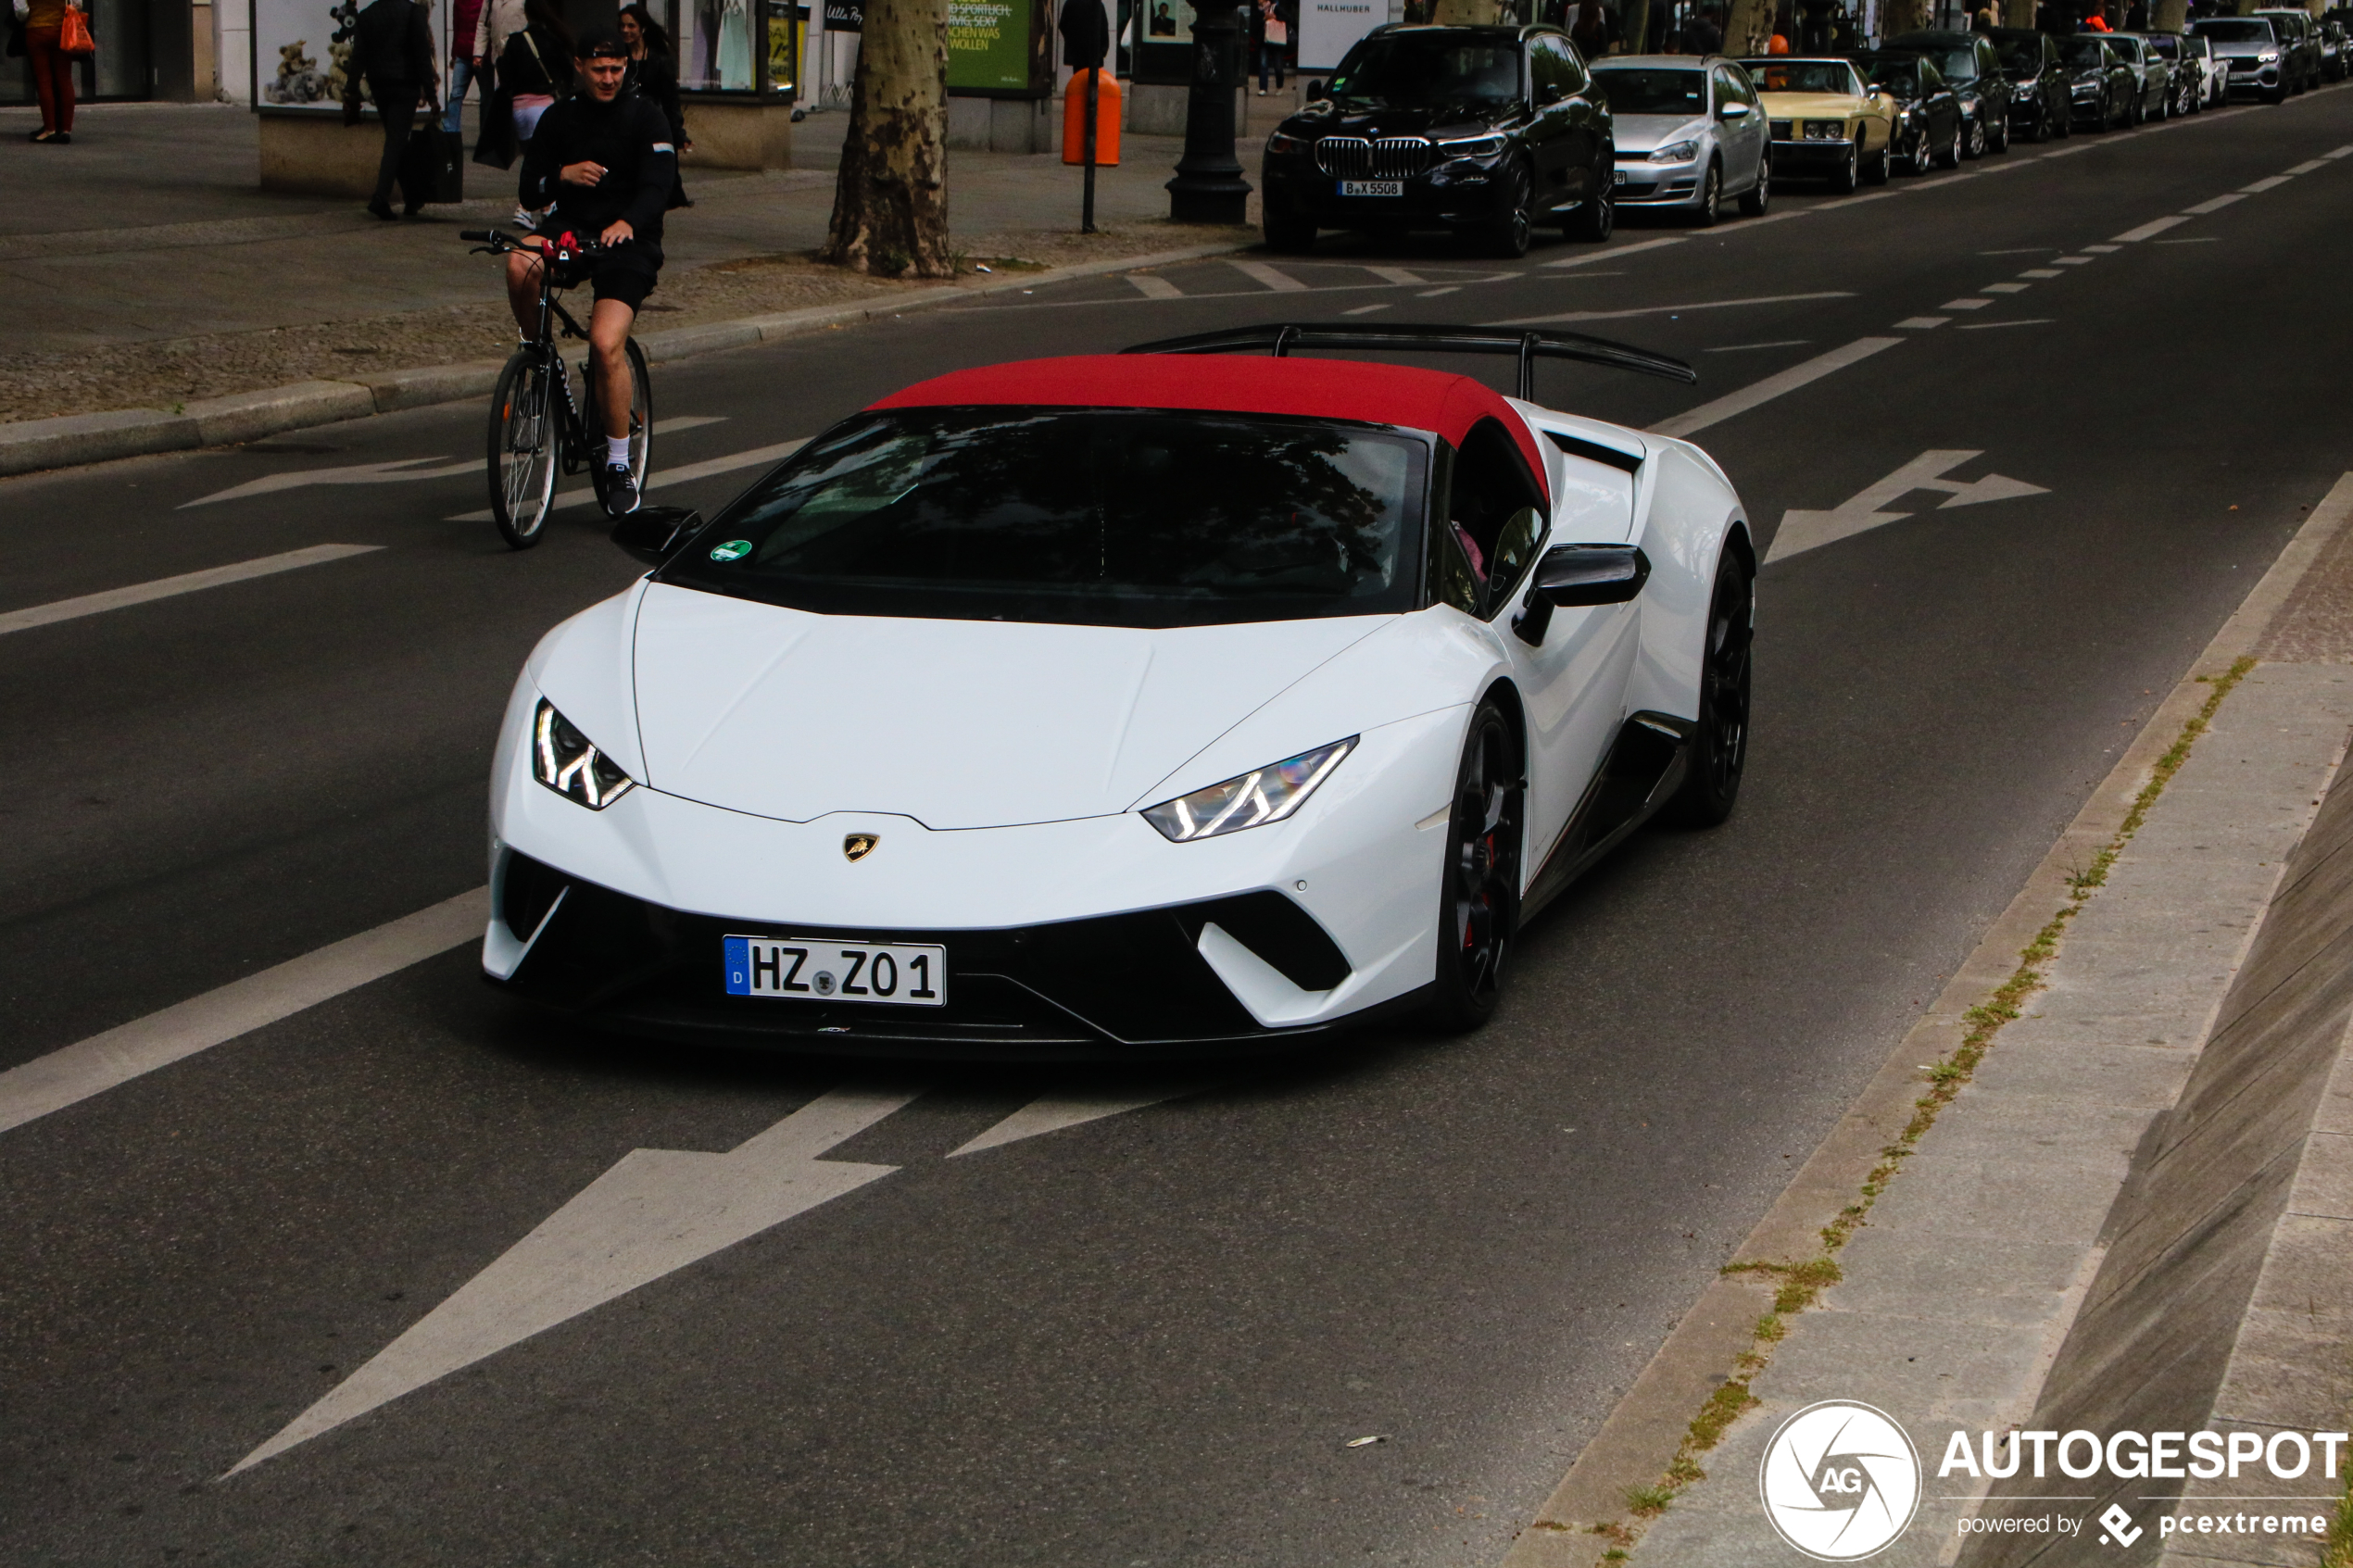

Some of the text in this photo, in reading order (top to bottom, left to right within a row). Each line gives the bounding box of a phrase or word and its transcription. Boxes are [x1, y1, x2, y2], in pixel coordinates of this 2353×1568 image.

[826, 4, 849, 20] Ulla
[1317, 5, 1370, 13] HALLHUBER
[975, 15, 998, 27] SEXY
[978, 27, 1000, 39] WAS
[950, 38, 988, 51] WOLLEN
[1346, 182, 1398, 194] B X 5508
[733, 972, 743, 984] D
[752, 945, 810, 992] HZ
